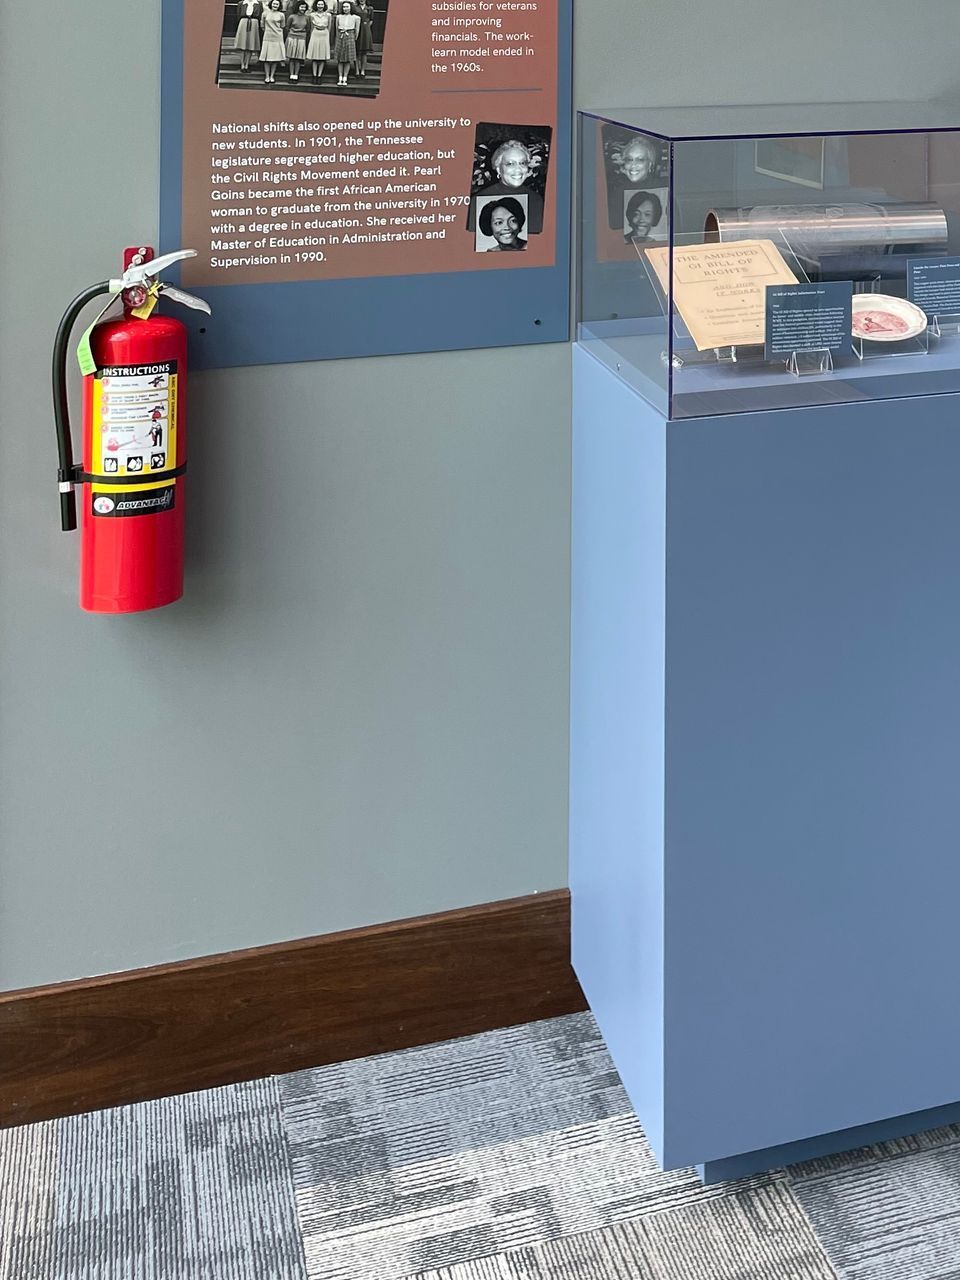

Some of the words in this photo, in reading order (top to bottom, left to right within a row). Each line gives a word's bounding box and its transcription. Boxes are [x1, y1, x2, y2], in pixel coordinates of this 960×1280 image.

[213, 122, 261, 133] National
[264, 122, 294, 132] shifts
[297, 121, 320, 131] also
[323, 120, 364, 132] opened
[368, 122, 381, 131] up
[384, 119, 402, 129] the
[405, 117, 457, 129] university
[460, 118, 471, 126] to
[239, 139, 291, 149] students.
[295, 138, 306, 147] In
[310, 137, 342, 148] 1901,
[345, 136, 363, 146] the
[366, 135, 423, 145] Tennessee
[704, 250, 758, 260] AMENDED
[704, 268, 750, 276] RIGHTS
[103, 364, 170, 376] INSTRUCTIONS
